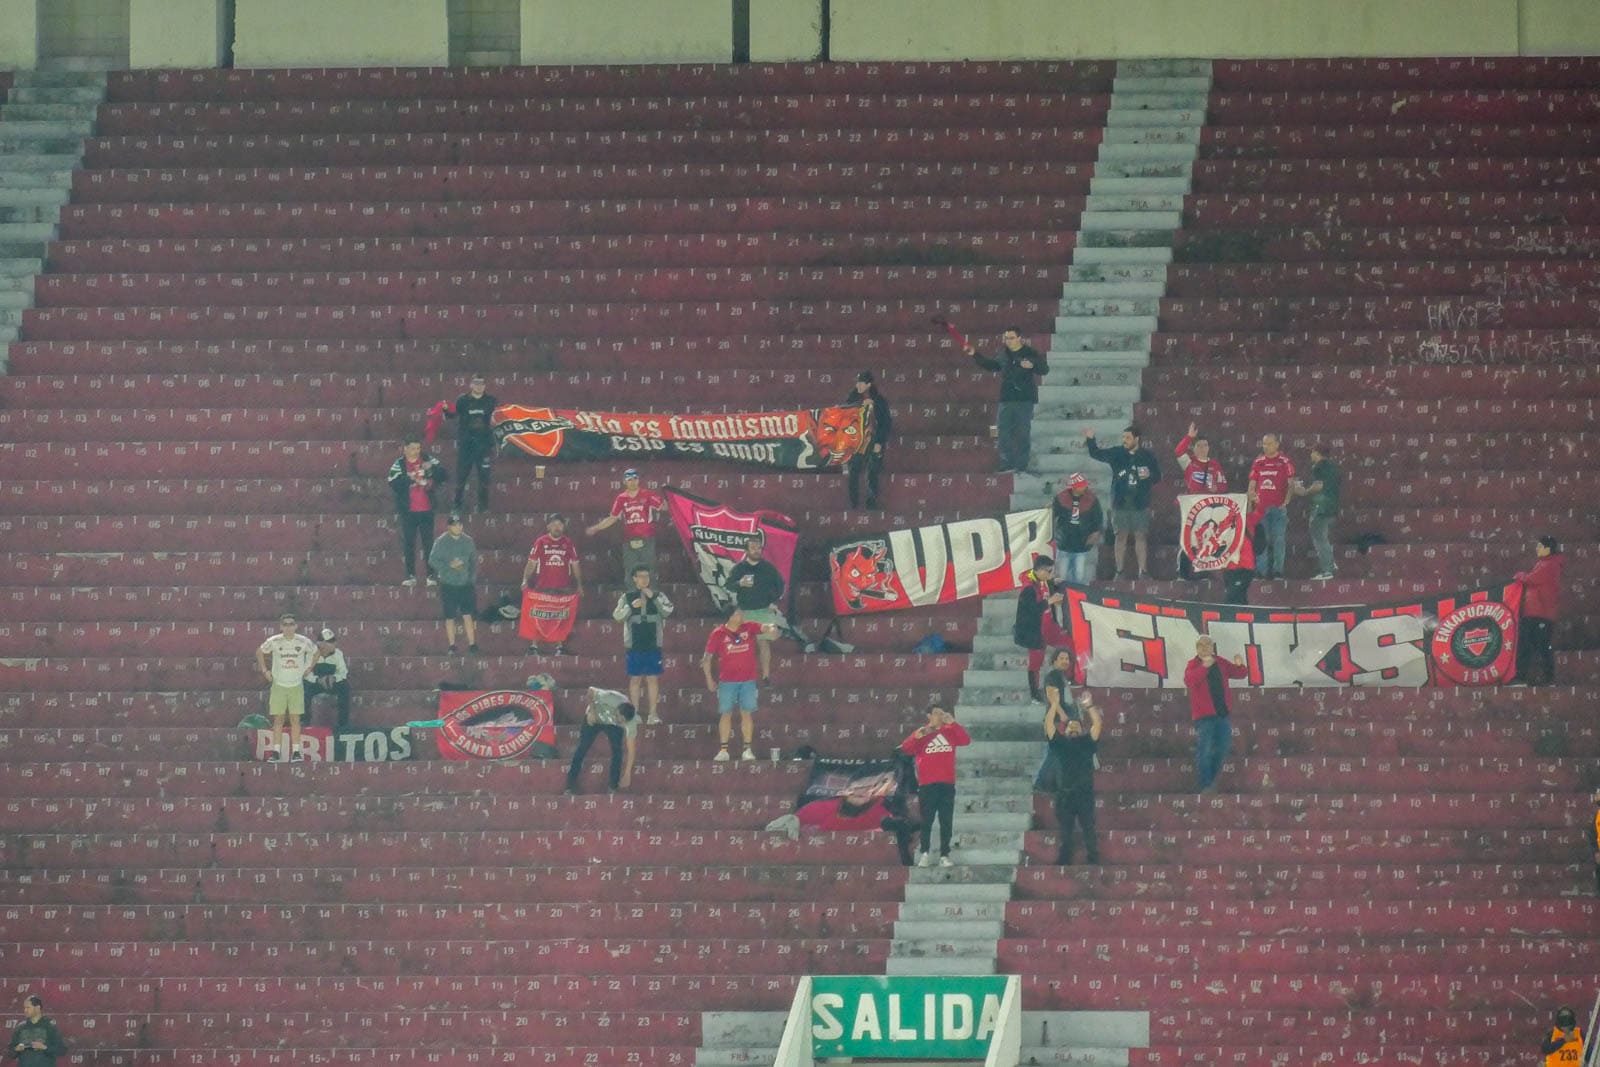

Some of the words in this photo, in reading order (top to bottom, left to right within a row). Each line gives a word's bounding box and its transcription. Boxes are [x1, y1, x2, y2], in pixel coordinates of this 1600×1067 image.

[693, 67, 703, 75] 17
[684, 101, 696, 110] 17
[933, 98, 944, 107] 24
[777, 134, 789, 143] 20
[887, 132, 898, 142] 23
[1031, 132, 1042, 140] 27
[766, 168, 778, 177] 20
[807, 167, 818, 176] 21
[92, 174, 102, 183] 01
[830, 201, 841, 210] 22
[868, 201, 879, 210] 23
[1420, 197, 1431, 205] 07
[292, 207, 303, 216] 07
[463, 241, 473, 250] 12
[747, 237, 759, 246] 20
[488, 275, 498, 284] 13
[812, 271, 823, 280] 22
[853, 271, 864, 280] 23
[438, 310, 448, 318] 12
[731, 307, 742, 315] 20
[840, 305, 852, 314] 23
[114, 312, 125, 320] 03
[257, 311, 268, 319] 07
[612, 342, 623, 351] 17
[650, 341, 661, 350] 18
[1385, 370, 1397, 378] 07
[1537, 370, 1546, 378] 11
[234, 379, 246, 387] 07
[601, 376, 612, 384] 17
[1264, 406, 1276, 414] 04
[1299, 406, 1311, 415] 05
[1527, 404, 1537, 412] 11
[75, 414, 87, 423] 03
[221, 413, 232, 422] 07
[373, 413, 382, 421] 11
[1369, 439, 1381, 447] 07
[26, 449, 37, 457] 02
[210, 446, 222, 455] 07
[568, 481, 580, 490] 17
[718, 480, 728, 488] 21
[753, 479, 766, 488] 22
[792, 479, 804, 488] 23
[942, 478, 952, 486] 27
[187, 520, 198, 528] 07
[336, 519, 345, 528] 11
[161, 593, 172, 601] 07
[894, 657, 906, 667] 27
[1472, 691, 1482, 700] 11
[457, 735, 493, 757] SANTA
[925, 745, 953, 755] adidas
[252, 767, 262, 776] 11
[330, 766, 340, 775] 13
[672, 765, 684, 775] 22
[547, 801, 557, 810] 19
[623, 800, 634, 809] 21
[701, 800, 713, 810] 23
[1211, 798, 1223, 808] 05
[1410, 798, 1421, 807] 10
[162, 803, 174, 812] 09
[601, 872, 612, 880] 21
[836, 871, 848, 880] 27
[1033, 871, 1045, 880] 01
[1195, 870, 1207, 879] 05
[1393, 870, 1405, 879] 10
[6, 910, 19, 919] 06
[281, 910, 292, 919] 13
[358, 910, 369, 918] 15
[436, 909, 447, 919] 17
[551, 908, 562, 917] 20
[709, 907, 721, 917] 24
[827, 908, 839, 917] 27
[1021, 907, 1032, 915] 01
[1185, 906, 1198, 915] 05
[32, 948, 45, 957] 07
[578, 944, 589, 954] 21
[738, 945, 750, 953] 25
[1177, 944, 1189, 953] 05
[1456, 945, 1468, 953] 12
[528, 981, 540, 990] 20
[608, 980, 620, 990] 22
[1089, 980, 1102, 989] 03
[1128, 980, 1140, 988] 04
[1170, 980, 1183, 989] 05
[400, 1017, 411, 1025] 17
[638, 1017, 650, 1026] 23
[812, 993, 1001, 1041] SALIDA
[1242, 1017, 1254, 1025] 07
[1404, 1016, 1414, 1025] 11
[1485, 1017, 1497, 1026] 13
[191, 1054, 202, 1063] 12
[269, 1055, 280, 1063] 14
[1148, 1052, 1161, 1063] 05
